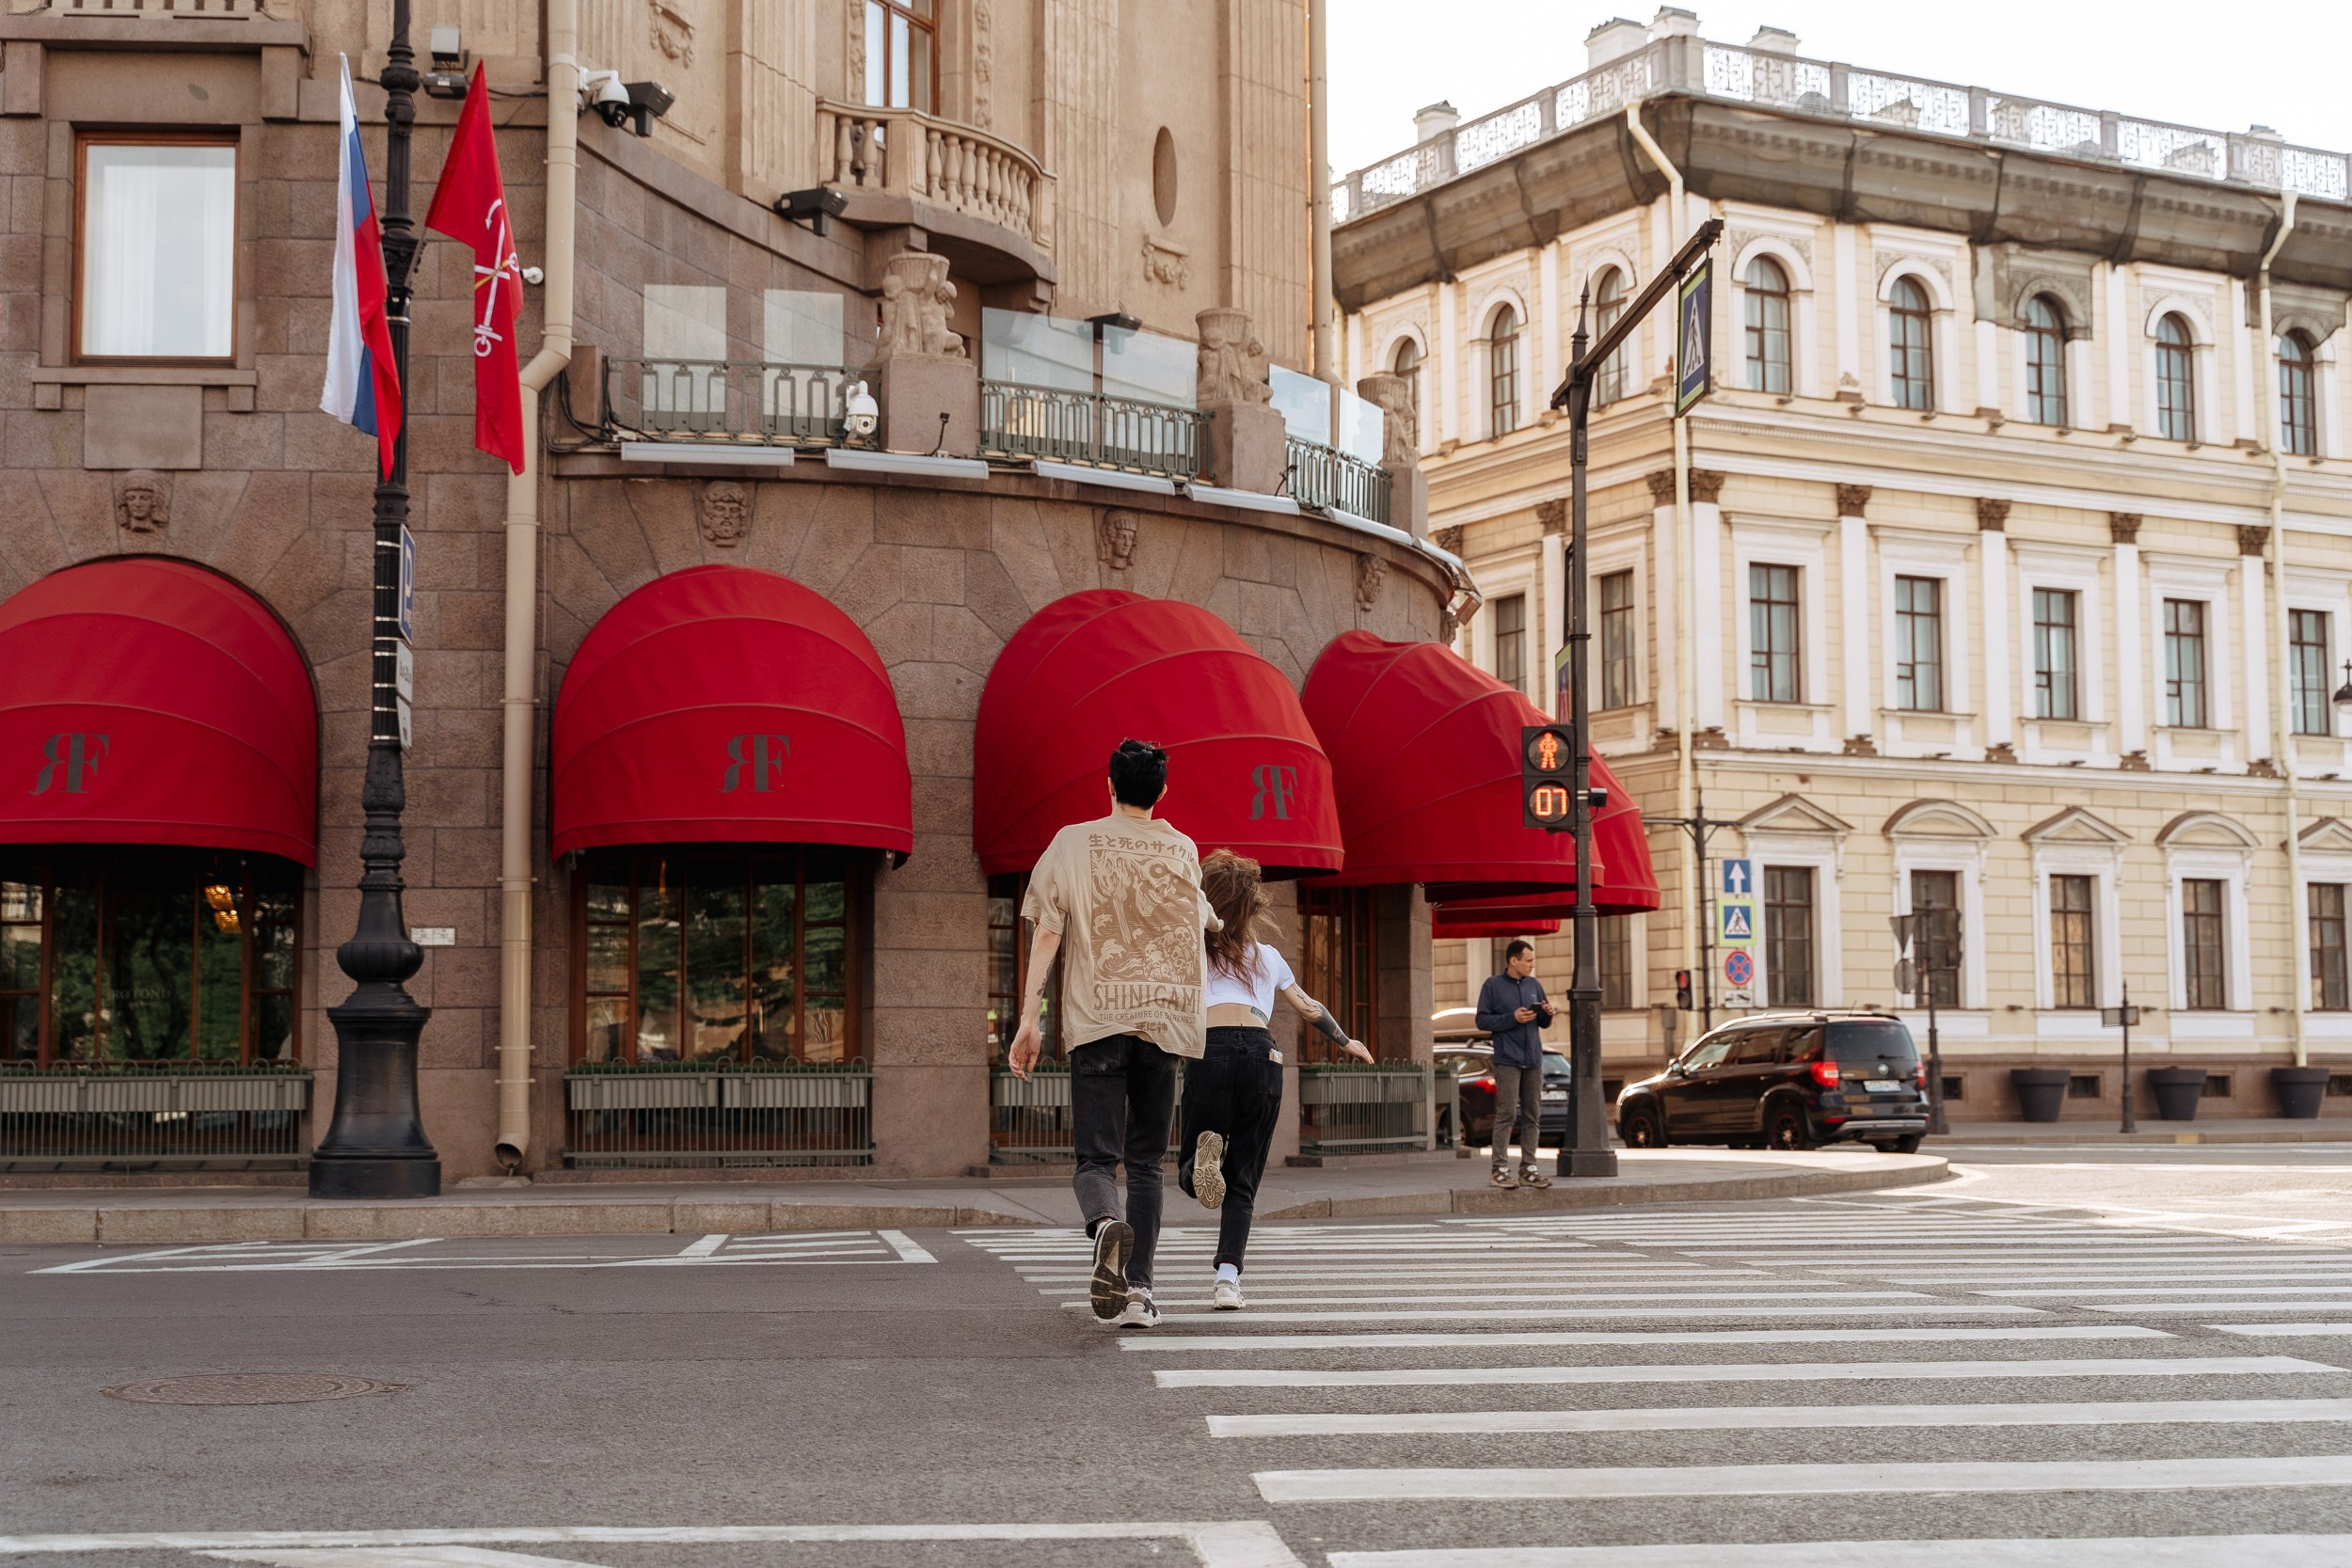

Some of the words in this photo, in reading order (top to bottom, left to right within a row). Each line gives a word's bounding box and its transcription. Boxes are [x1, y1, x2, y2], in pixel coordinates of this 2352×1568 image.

[1535, 788, 1567, 816] 07
[1089, 833, 1194, 863] 生と死のサイクル
[1093, 983, 1200, 1015] SHINIGAMI
[1100, 1013, 1114, 1022] THE
[1115, 1011, 1152, 1022] CREATURE
[1153, 1010, 1164, 1019] OF
[1165, 1012, 1197, 1024] DARKNESS
